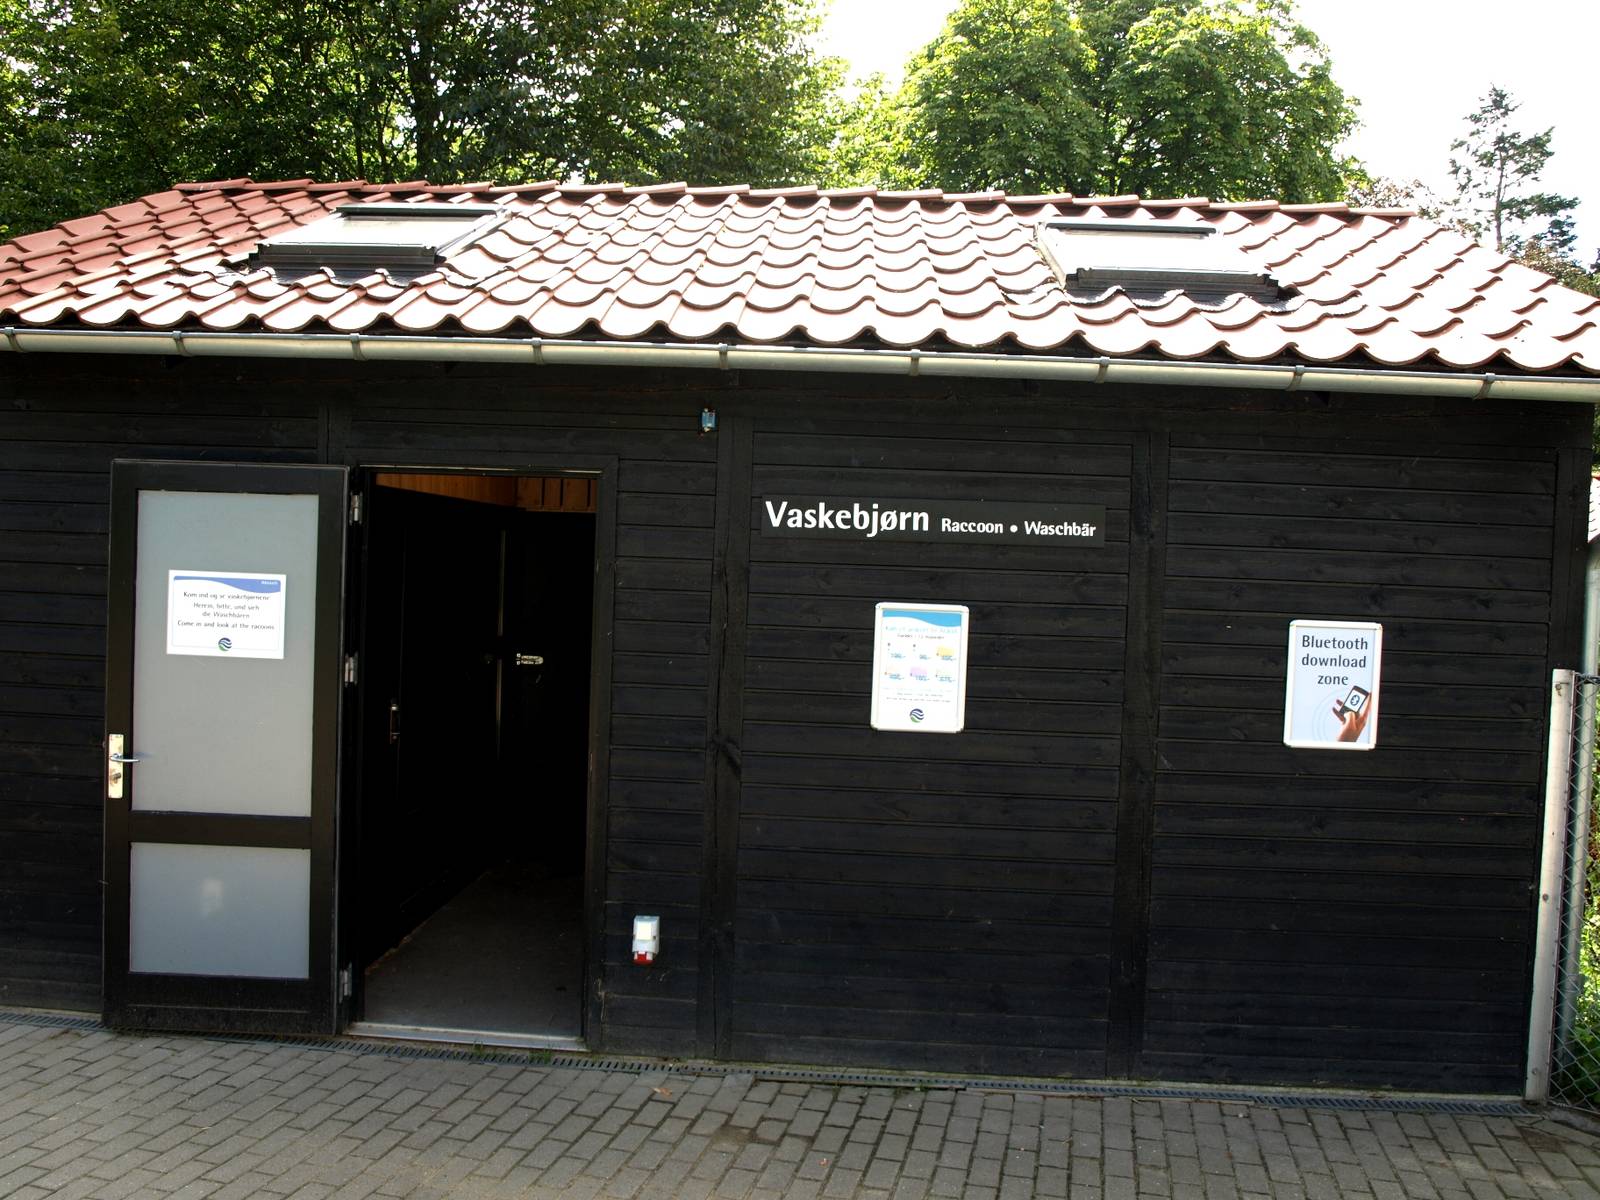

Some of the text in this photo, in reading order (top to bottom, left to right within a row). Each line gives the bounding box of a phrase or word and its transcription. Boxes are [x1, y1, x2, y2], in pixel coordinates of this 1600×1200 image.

[765, 500, 1096, 538] Vaskebjørn Raccoon Waschbär
[1302, 634, 1368, 650] Bluetooth
[1301, 653, 1367, 668] download
[1317, 674, 1349, 686] zone
